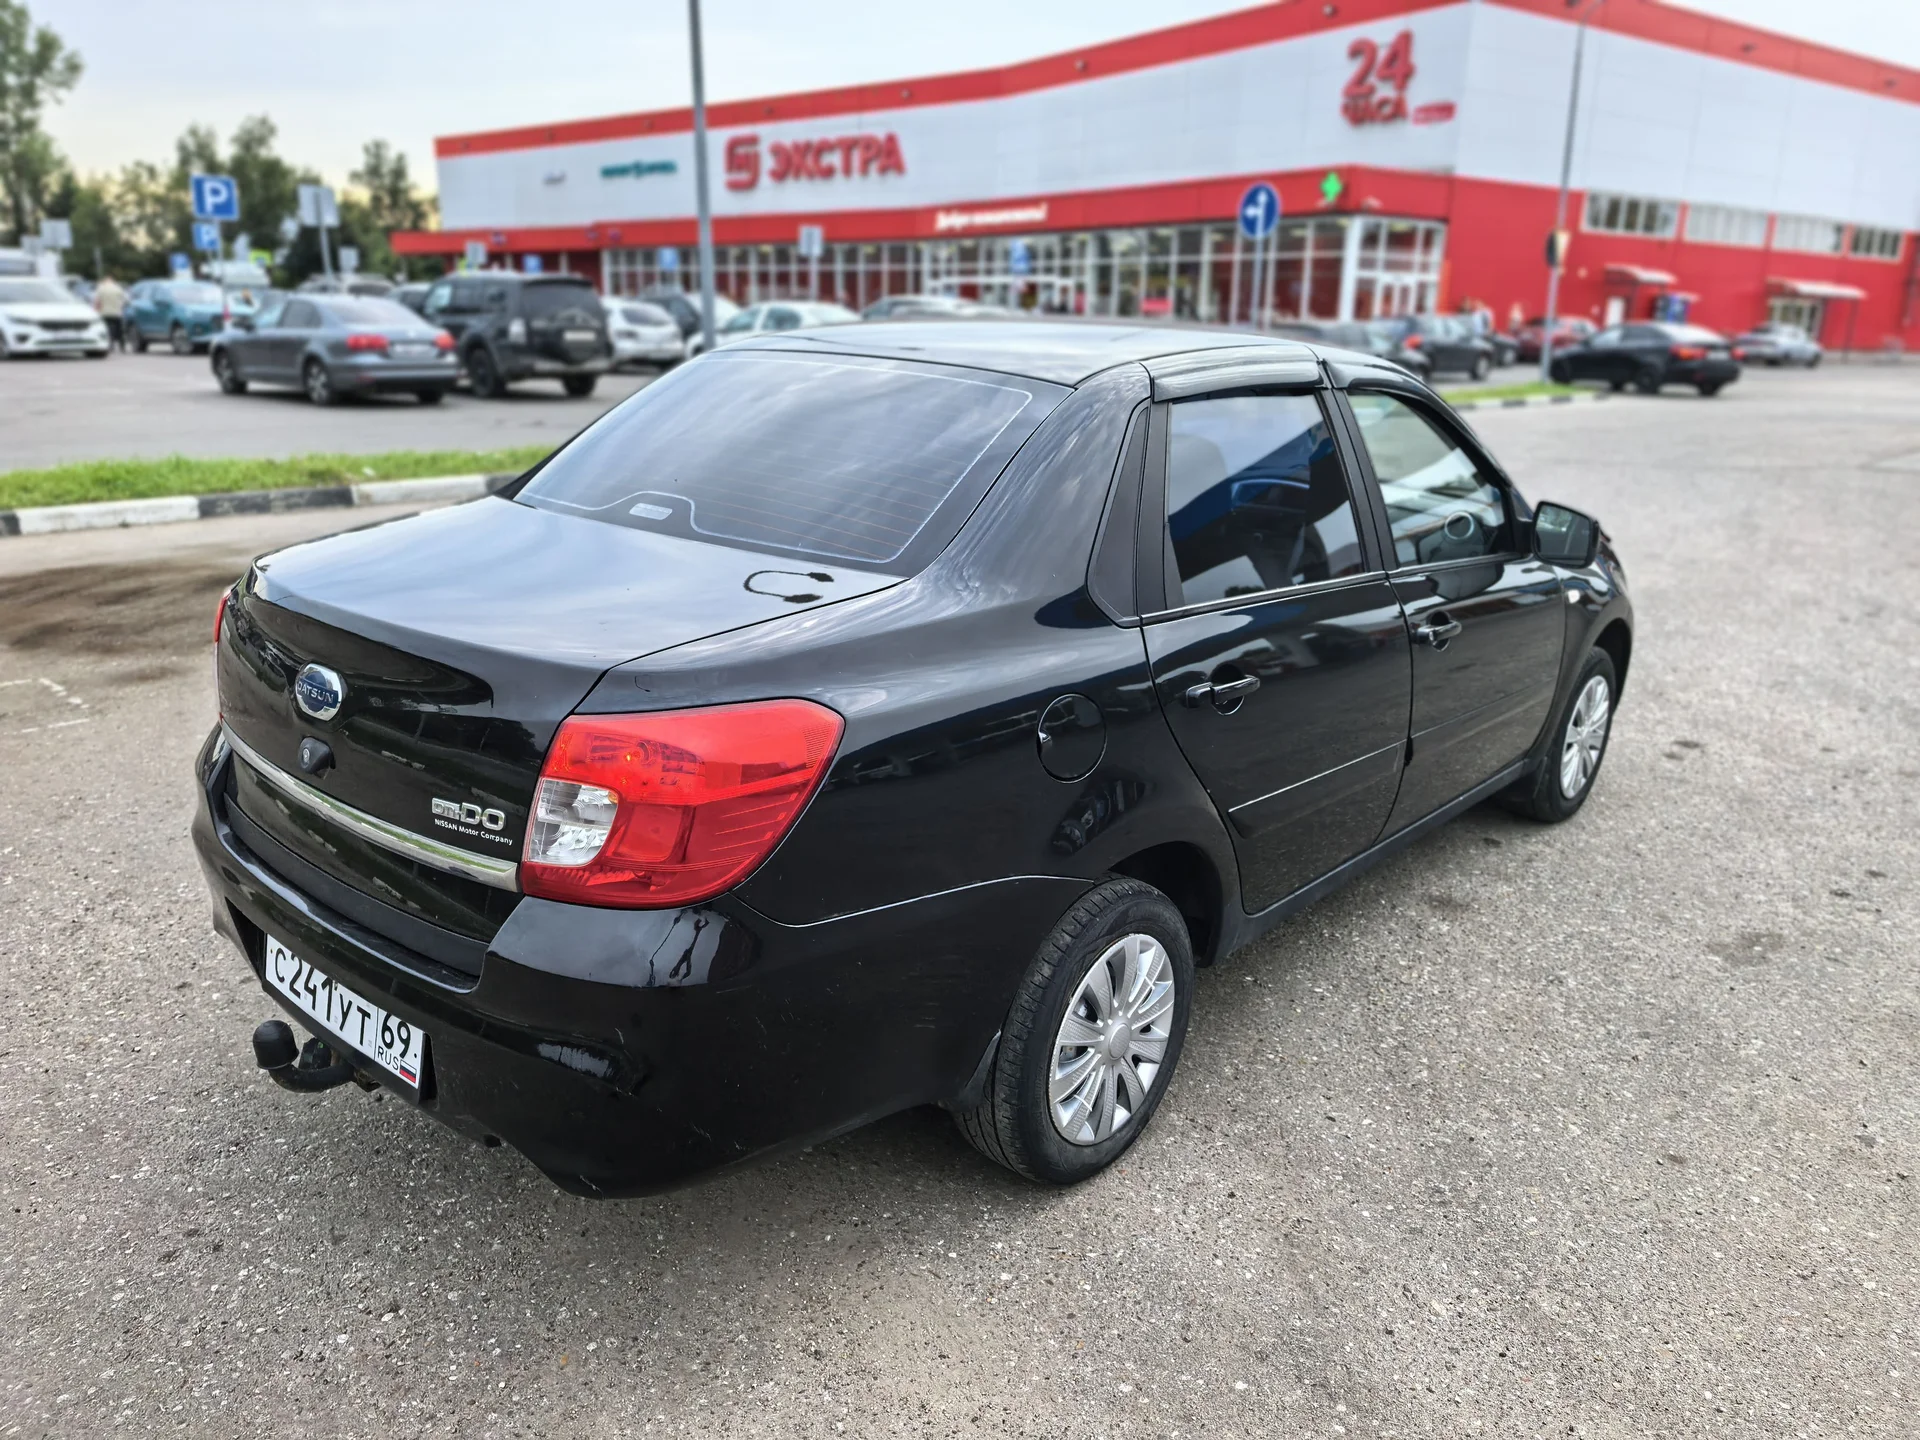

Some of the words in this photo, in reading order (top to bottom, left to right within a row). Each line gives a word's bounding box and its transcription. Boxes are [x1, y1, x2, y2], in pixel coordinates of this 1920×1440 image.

[1343, 29, 1415, 97] 24
[769, 132, 905, 181] ЭКСТРА
[297, 681, 334, 703] DATSUN
[434, 818, 458, 832] NISSAN
[458, 825, 479, 837] Motor
[480, 831, 513, 846] Company
[381, 1012, 411, 1059] 69
[377, 1045, 400, 1071] RUS
